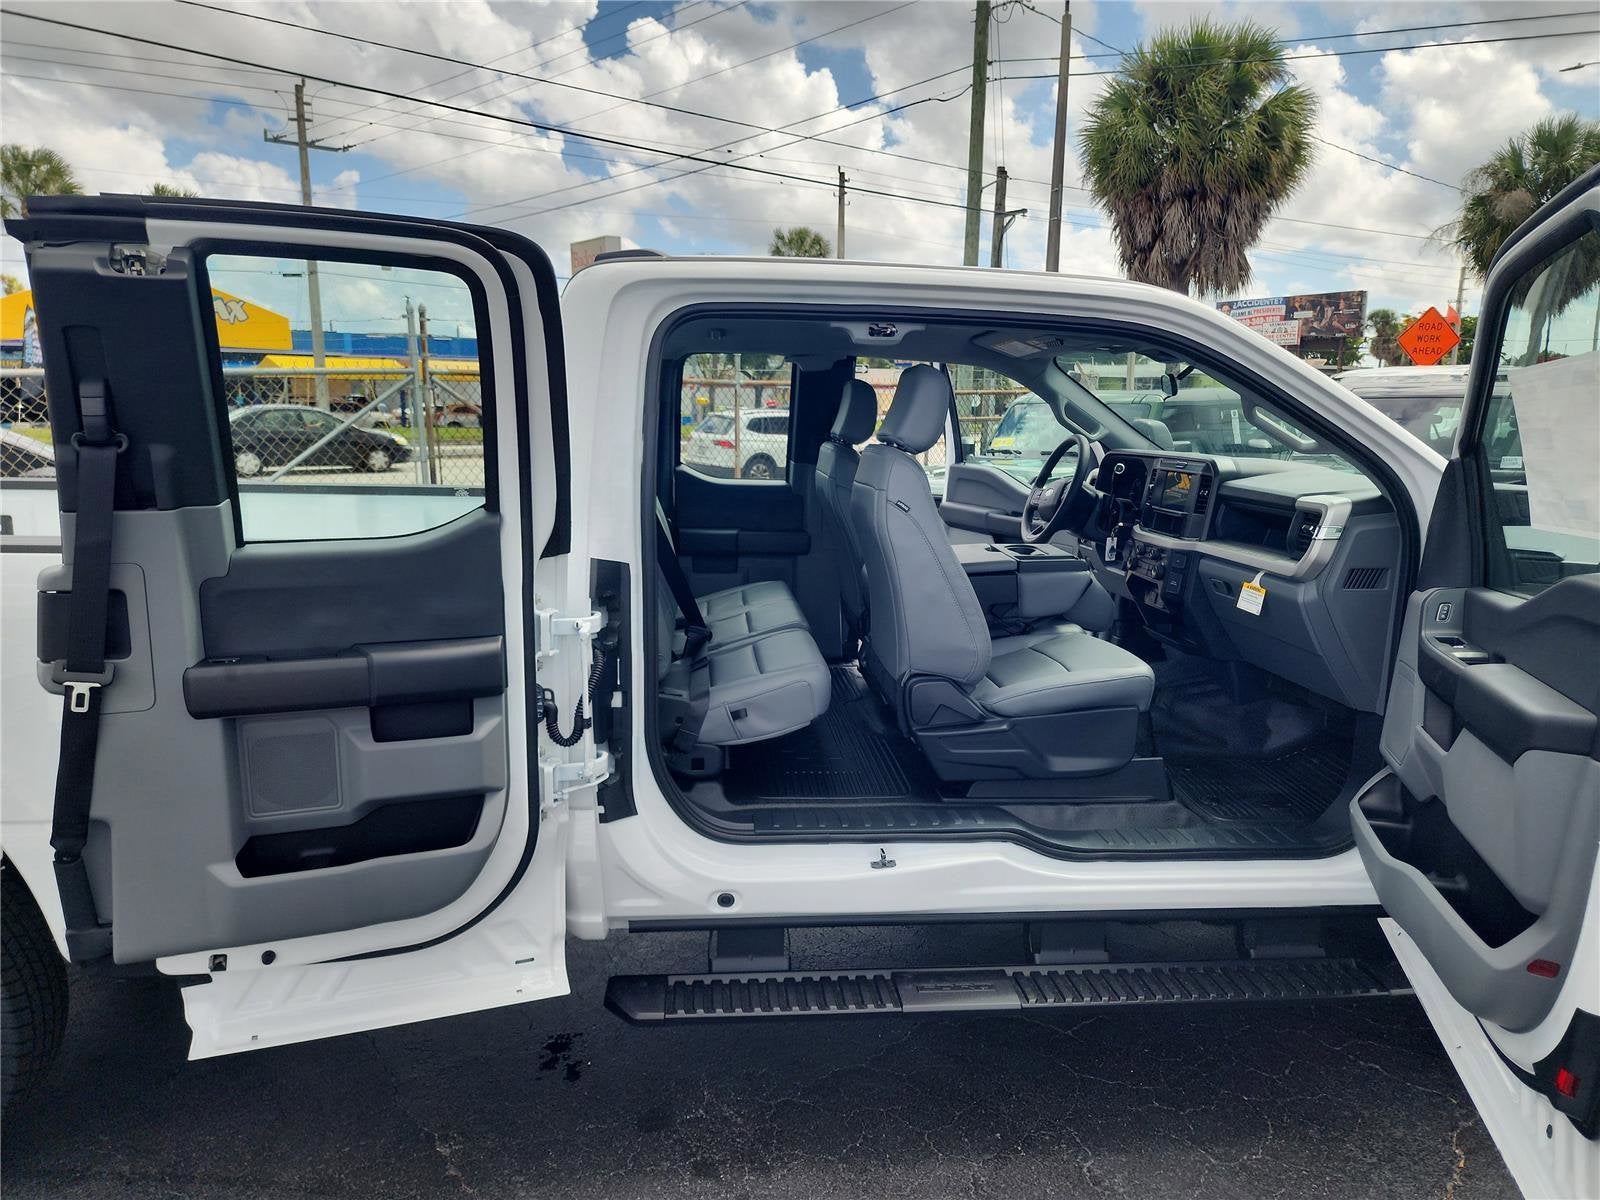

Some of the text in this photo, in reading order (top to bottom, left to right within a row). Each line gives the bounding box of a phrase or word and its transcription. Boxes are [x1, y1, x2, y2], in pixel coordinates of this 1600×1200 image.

[1232, 298, 1283, 309] ¿ACCIDENTE?
[1419, 323, 1443, 331] ROAD
[1417, 335, 1441, 343] WORK
[1412, 347, 1442, 355] AHEAD
